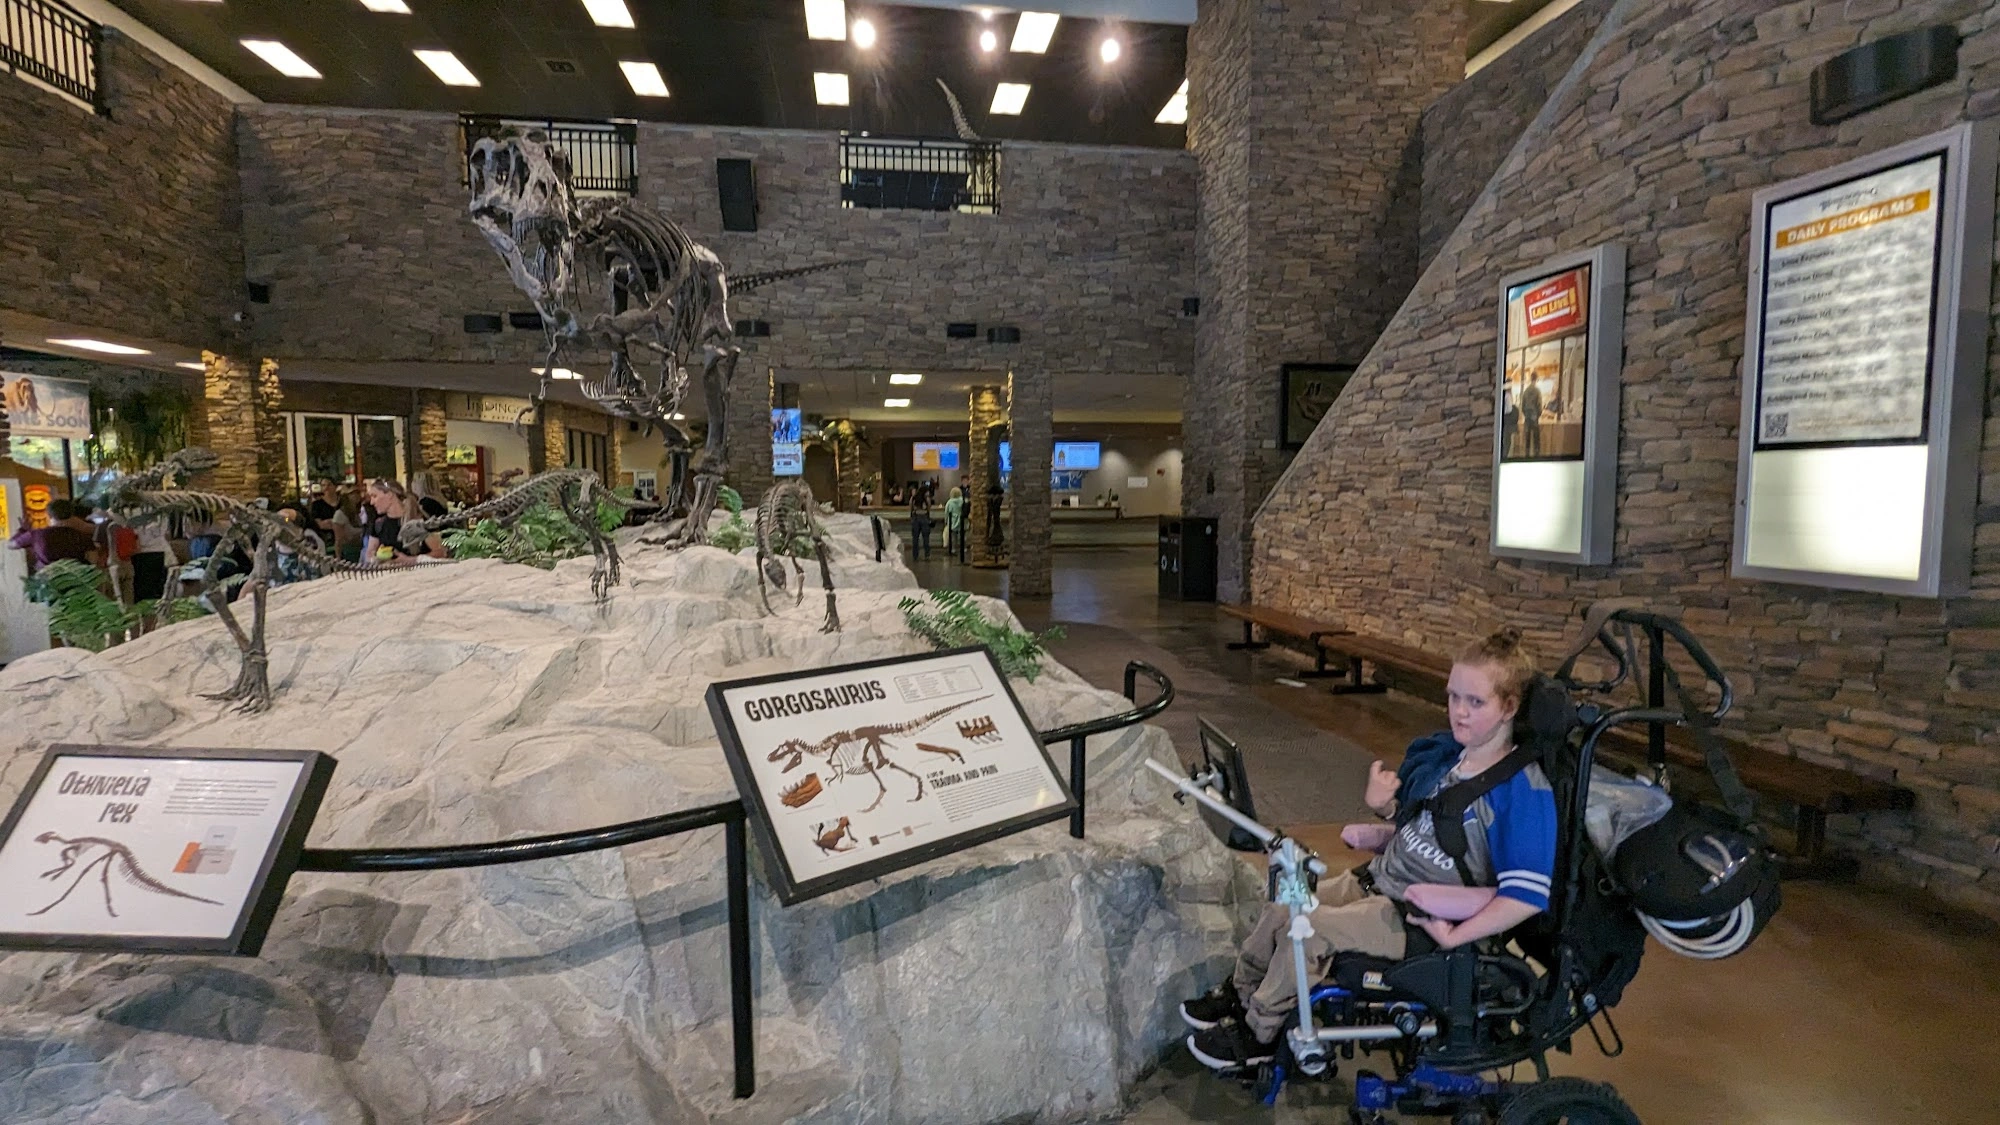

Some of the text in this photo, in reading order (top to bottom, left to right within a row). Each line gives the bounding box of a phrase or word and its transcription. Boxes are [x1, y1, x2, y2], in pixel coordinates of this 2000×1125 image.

[1787, 221, 1826, 244] DAILY
[1829, 196, 1916, 233] PROGRAMS
[46, 414, 89, 428] SOON
[744, 679, 887, 722] GORGOSAURUS
[929, 773, 963, 789] TRAUMA
[963, 768, 980, 781] AND
[98, 802, 139, 823] rex
[1400, 823, 1455, 871] ougars
